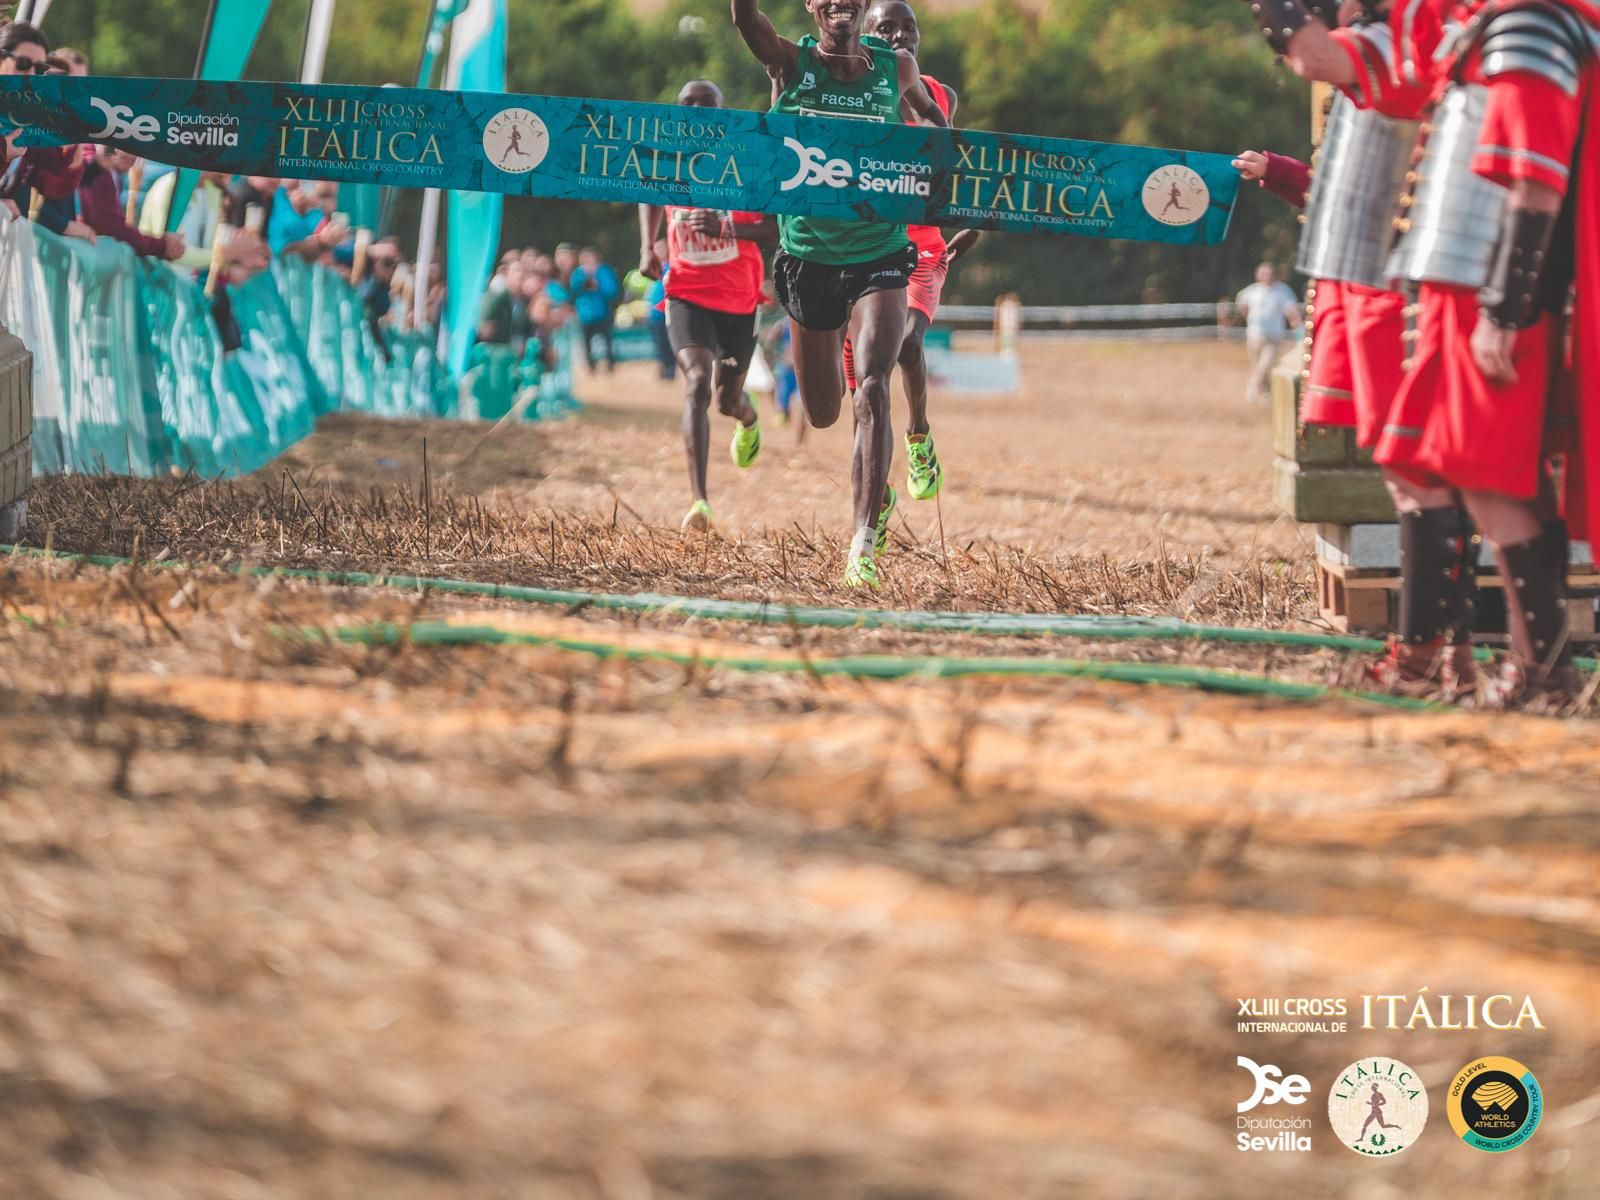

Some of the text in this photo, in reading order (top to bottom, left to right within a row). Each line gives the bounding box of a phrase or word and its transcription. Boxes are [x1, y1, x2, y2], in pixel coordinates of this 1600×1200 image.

[167, 111, 240, 127] Diputación
[283, 97, 426, 123] XLIII CROSS
[166, 126, 239, 147] Sevilla
[583, 113, 726, 142] XLIII CROSS
[279, 122, 445, 165] ITÁLICA
[278, 157, 445, 175] INTERNATIONAL CROSS COUNTRY
[578, 141, 745, 187] ITÁLICA
[859, 157, 932, 174] Diputación
[955, 144, 1097, 175] XLIII CROSS
[578, 176, 744, 198] INTERNATIONAL CROSS COUNTRY
[858, 172, 931, 196] Sevilla
[950, 171, 1115, 218] ITÁLICA
[949, 207, 1114, 228] INTERNATIONAL CROSS COUNTRY
